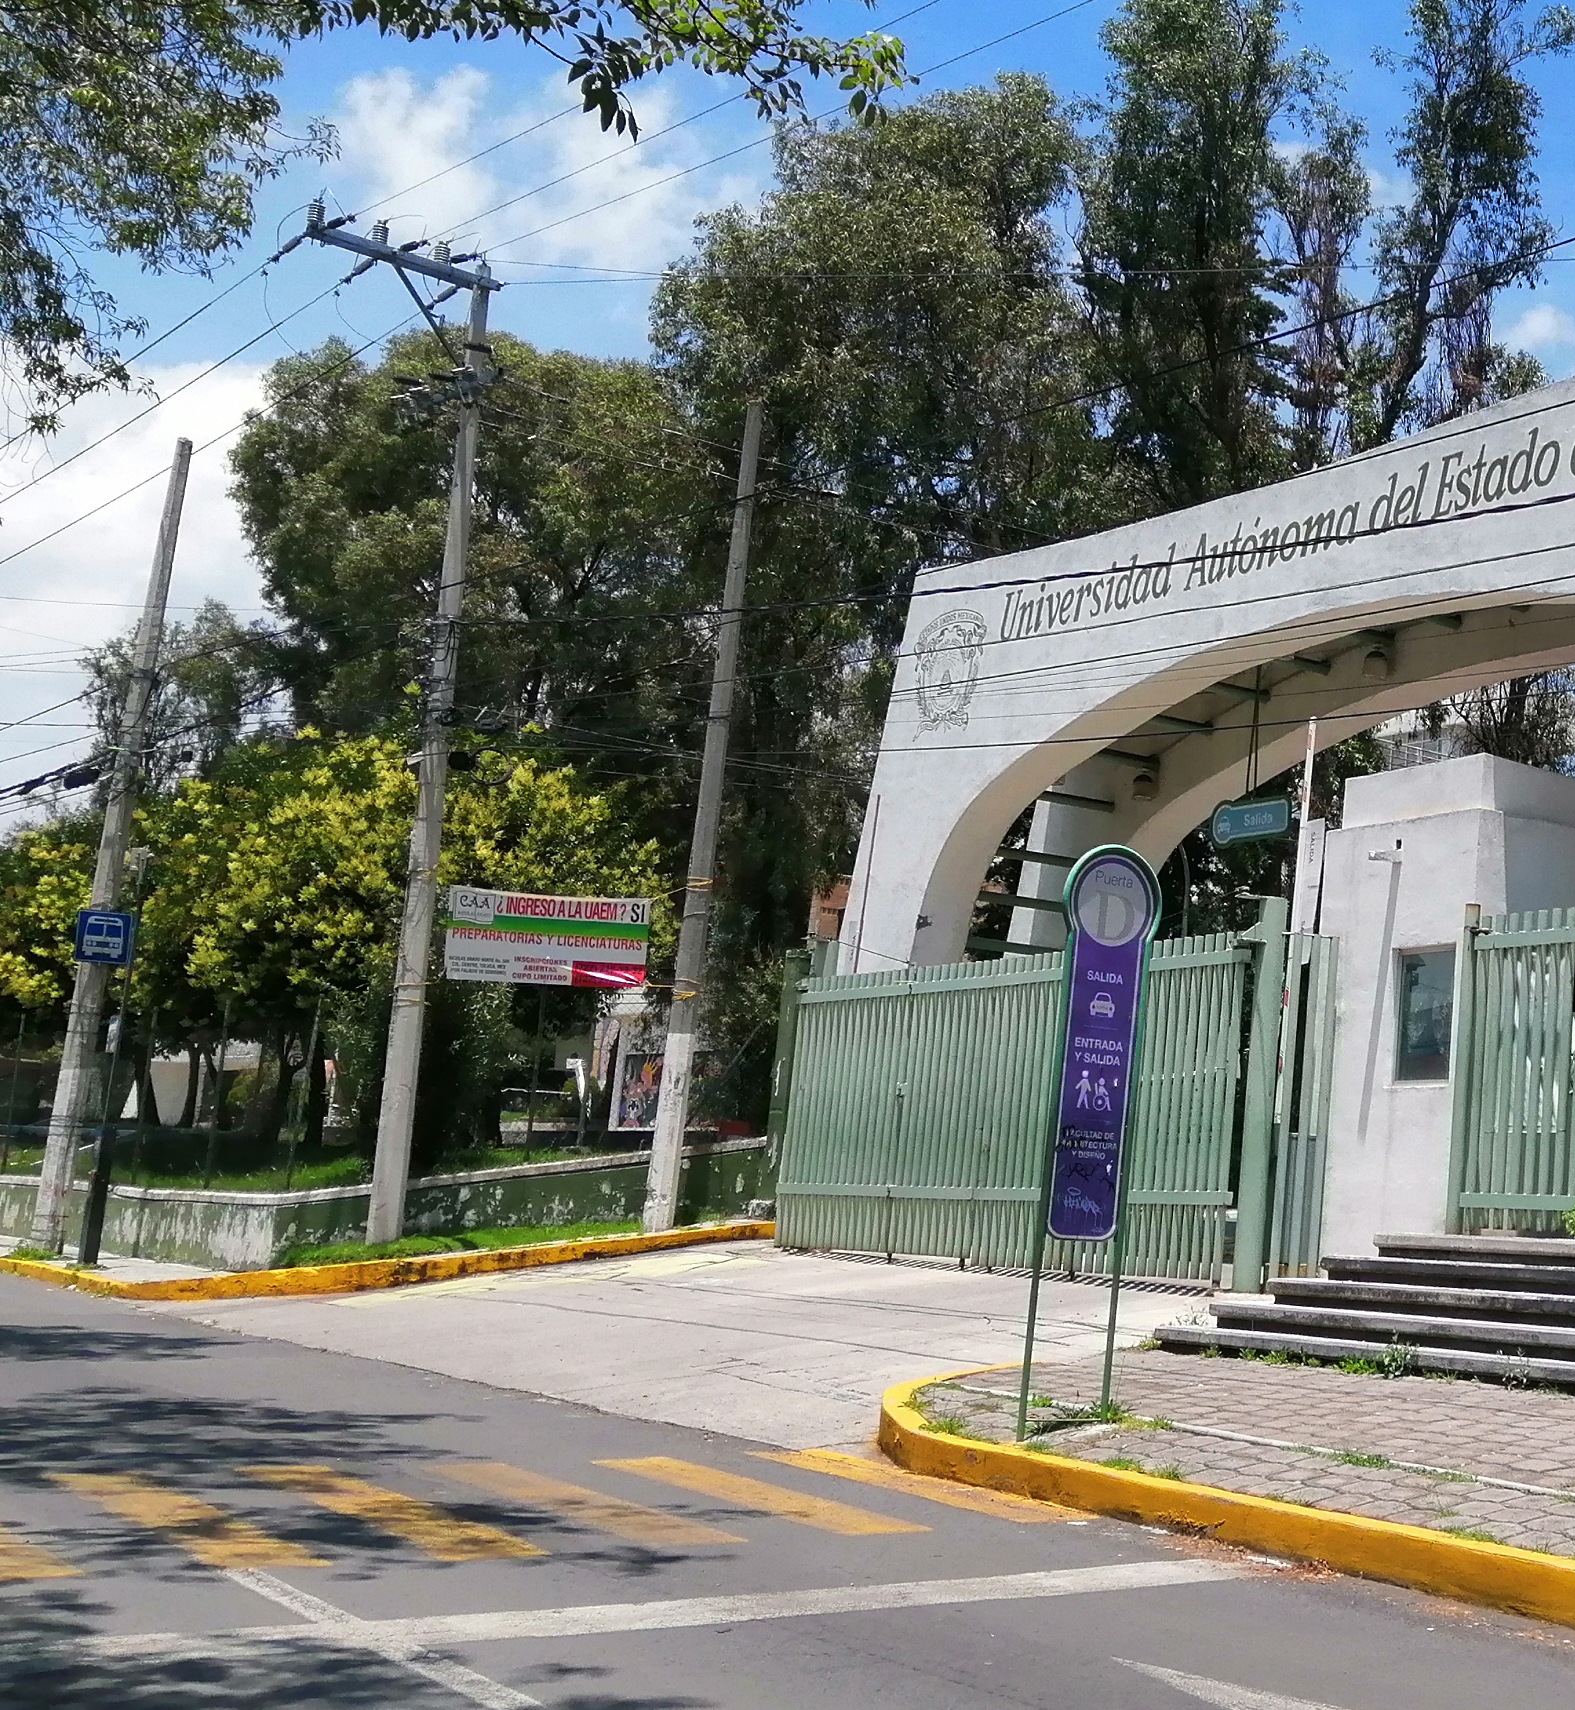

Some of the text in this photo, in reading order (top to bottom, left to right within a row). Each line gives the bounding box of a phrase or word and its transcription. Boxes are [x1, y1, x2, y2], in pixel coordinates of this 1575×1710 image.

[1000, 542, 1177, 641] Universidad
[1183, 499, 1361, 592] Autónoma
[1368, 461, 1430, 531] del
[1431, 426, 1560, 520] Estado
[1243, 811, 1273, 827] Salida
[1095, 870, 1134, 889] Puerta
[460, 894, 490, 909] CAA
[506, 896, 556, 917] INGRESO
[557, 900, 565, 918] A
[568, 900, 582, 919] LA
[584, 901, 618, 921] UAEM
[1096, 890, 1135, 941] D
[452, 927, 642, 951] PREPARATORIAS Y LICENCIATURAS
[514, 956, 568, 966] INSCRIPCIONES
[524, 964, 557, 973] ABIERTAS
[512, 972, 532, 980] CUPO
[534, 973, 568, 981] LIMITADO
[1086, 970, 1124, 985] SALIDA
[1074, 1036, 1123, 1052] ENTRADA
[1074, 1051, 1121, 1066] Y SALIDA
[1104, 1131, 1115, 1140] DE
[1071, 1150, 1078, 1158] Y
